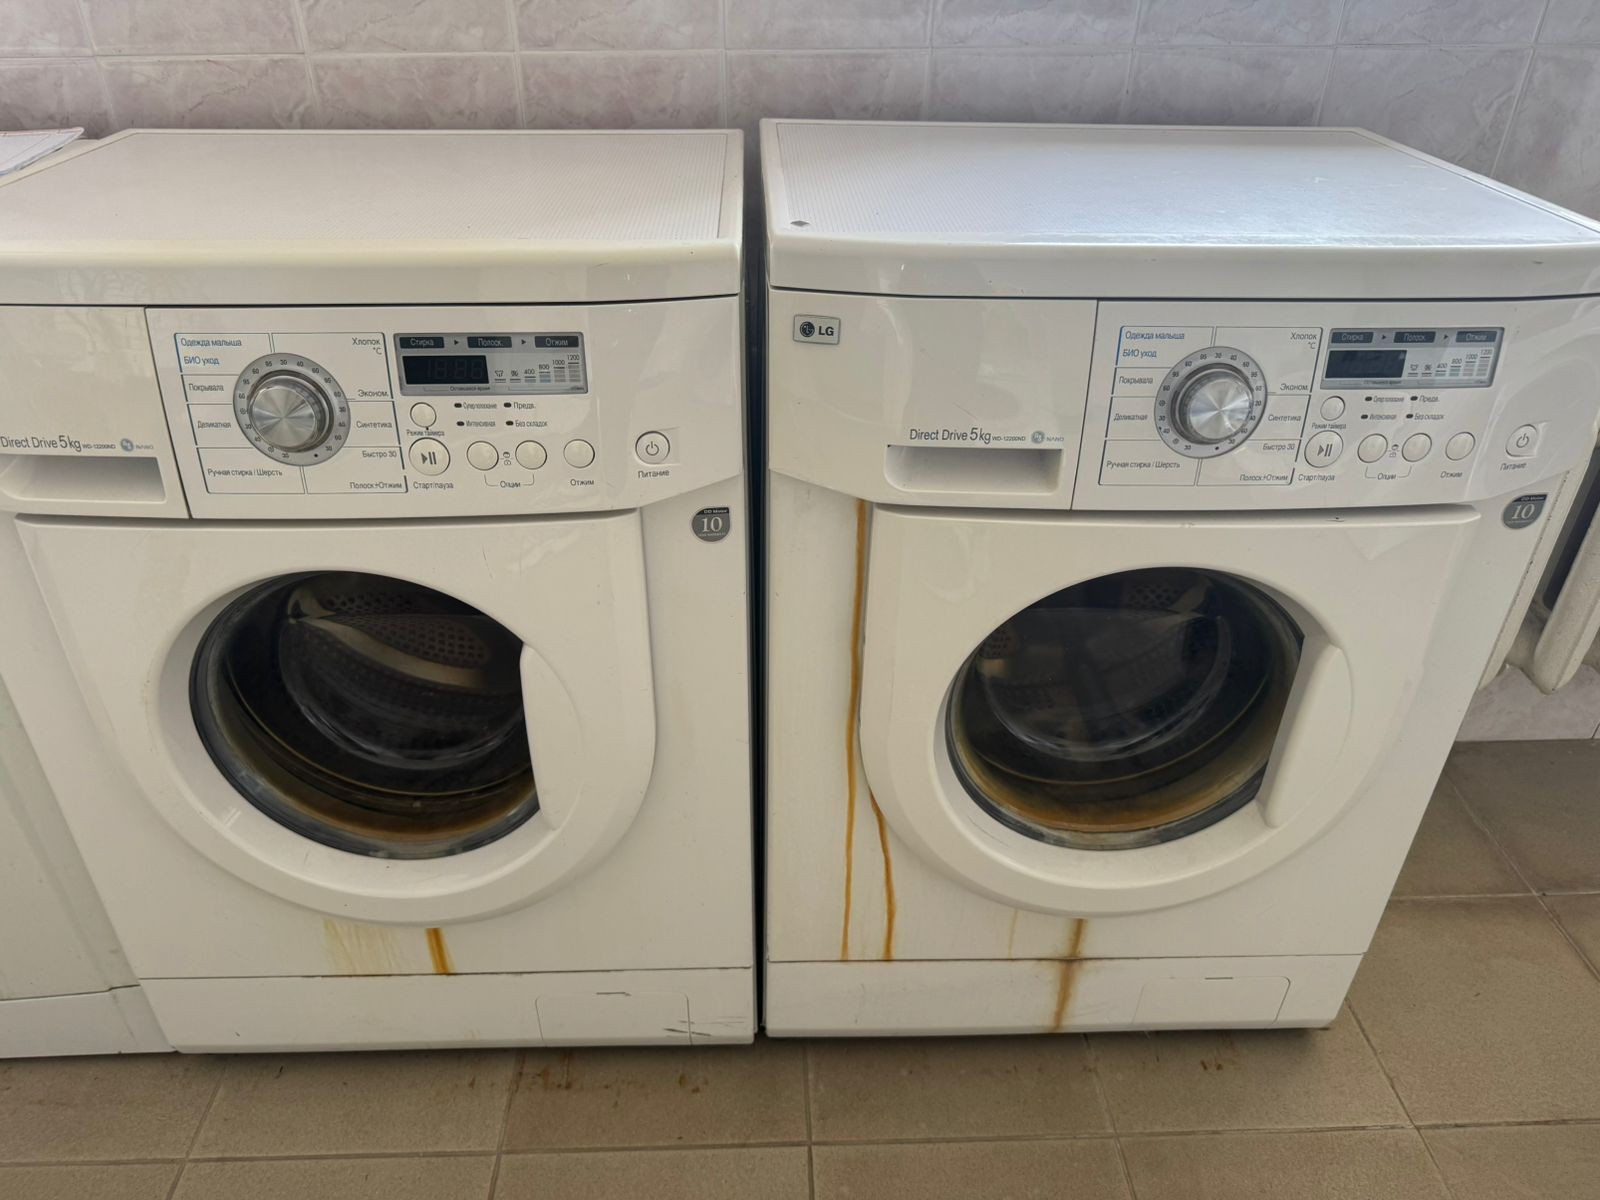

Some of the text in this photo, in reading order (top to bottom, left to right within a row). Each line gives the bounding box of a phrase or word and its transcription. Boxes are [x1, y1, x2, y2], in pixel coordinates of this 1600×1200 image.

[818, 326, 834, 336] LG
[1125, 331, 1185, 341] Одежда малыша
[1290, 332, 1317, 340] Хлопок
[1466, 333, 1488, 341] Отжим
[181, 338, 241, 347] Одежда малыша
[352, 337, 381, 345] Хлопок
[410, 338, 434, 346] Стирка
[545, 338, 568, 346] Отжим
[1123, 349, 1157, 359] БИО уход
[184, 357, 219, 366] БИО уход
[1119, 376, 1153, 385] Покрывала
[189, 384, 224, 392] Покрывала
[1280, 383, 1309, 391] Эконом.
[358, 389, 389, 397] Эконом.
[1114, 413, 1147, 422] Деликатная
[1268, 414, 1301, 422] Синтетика
[198, 421, 231, 429] Деликатная
[356, 421, 392, 429] Синтетика
[910, 429, 939, 440] Direct
[942, 429, 967, 440] Drive
[0, 436, 32, 448] Direct
[32, 437, 57, 448] Drive
[1263, 443, 1286, 451] Быстро
[362, 450, 387, 458] Быстро
[1106, 461, 1129, 469] Ручная
[1155, 461, 1180, 469] Шерсть
[208, 468, 230, 477] Ручная
[231, 469, 253, 477] стирка
[257, 468, 282, 477] Шерсть
[638, 470, 669, 478] Питание
[413, 482, 453, 490] Старт/пауза
[1512, 504, 1535, 519] 10
[702, 517, 722, 532] 10
